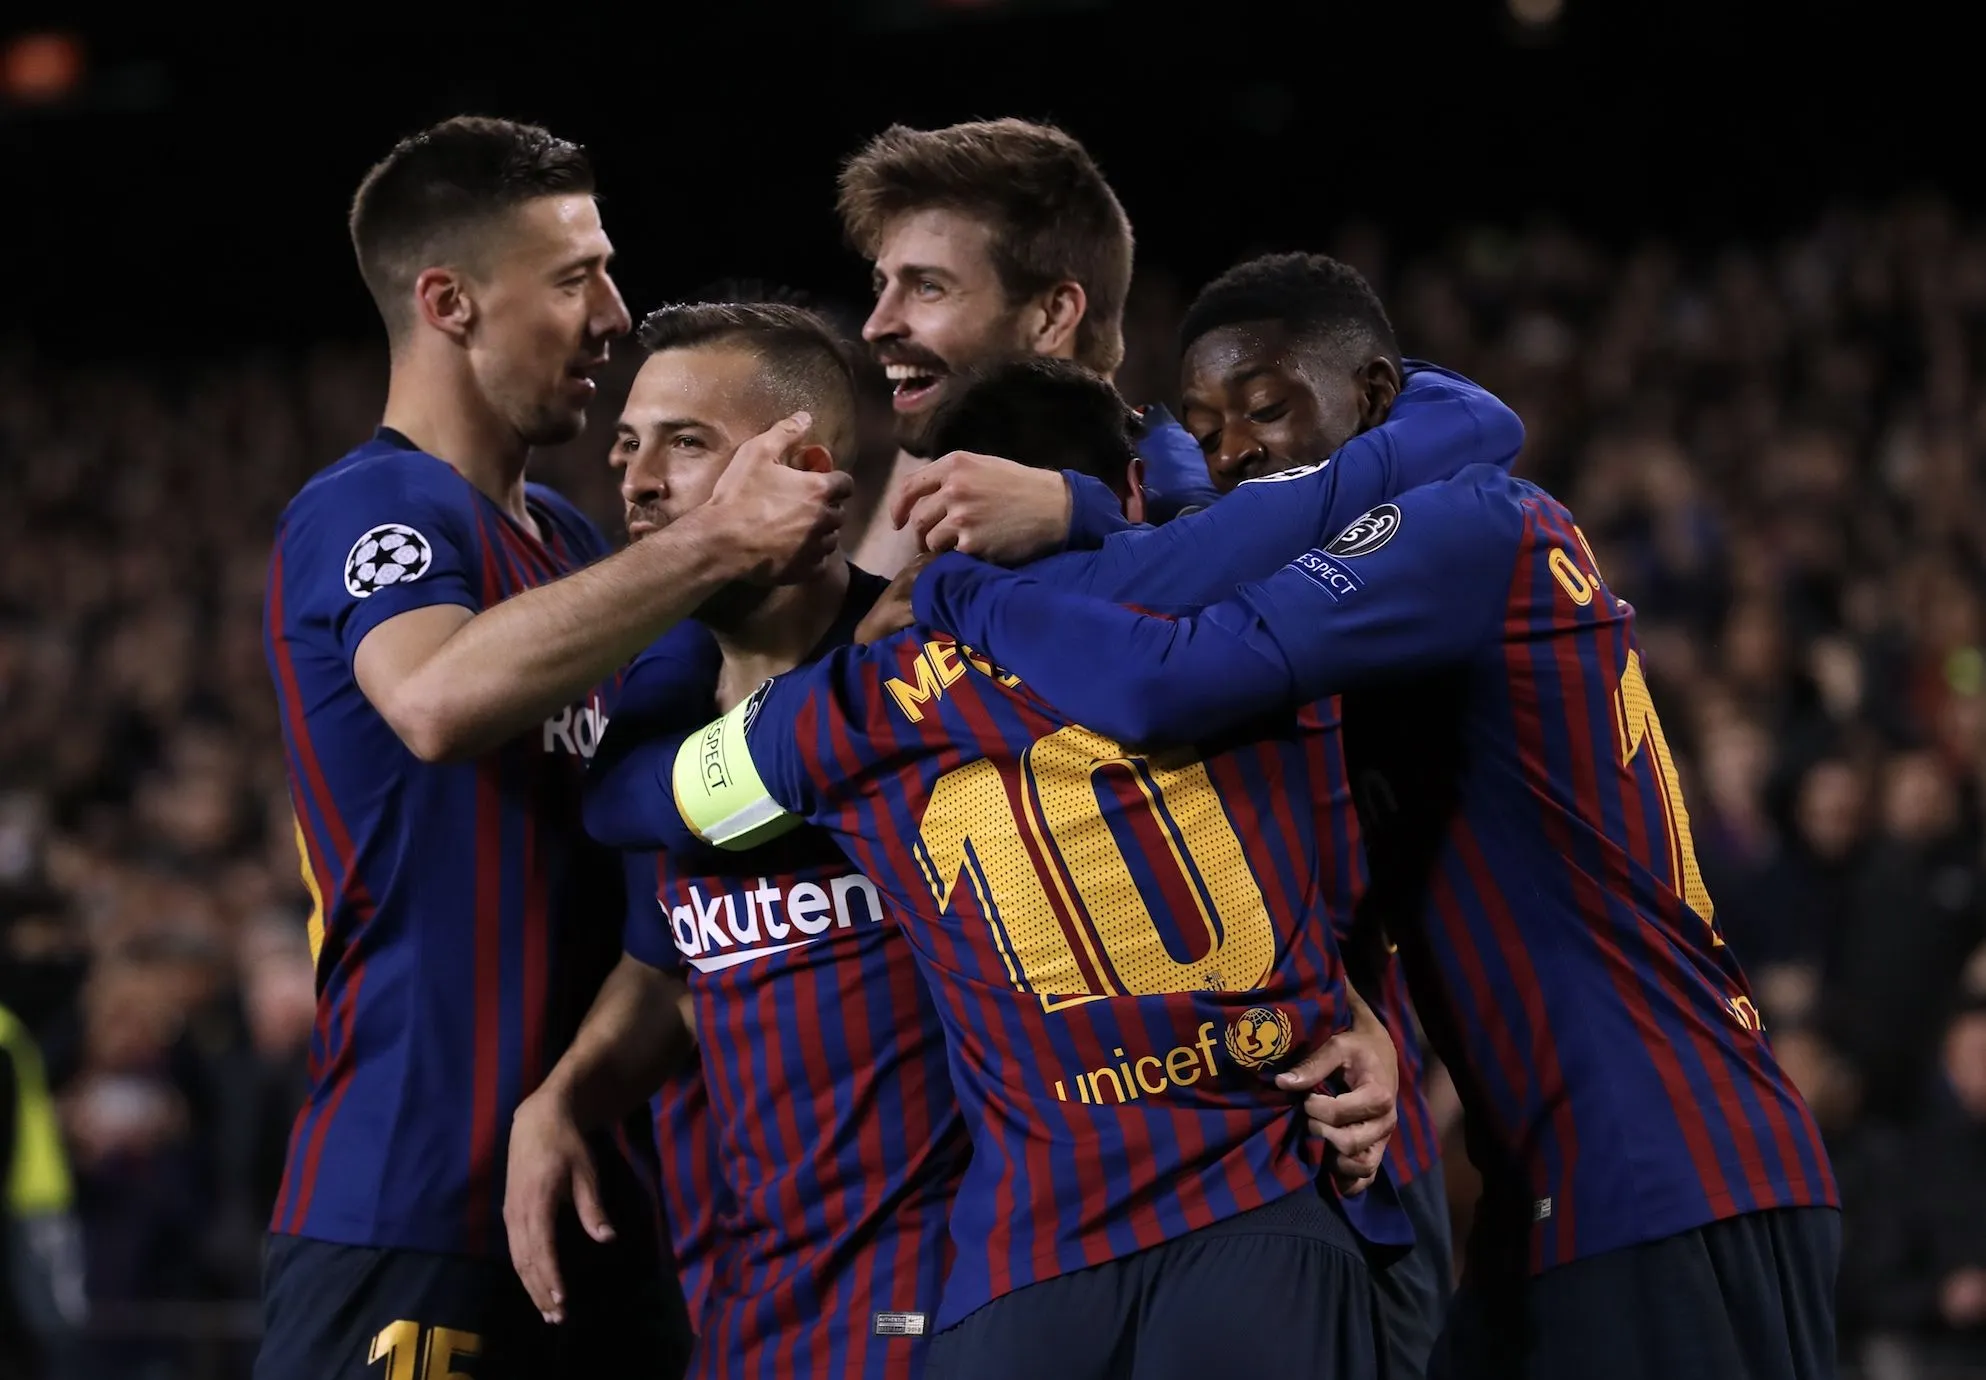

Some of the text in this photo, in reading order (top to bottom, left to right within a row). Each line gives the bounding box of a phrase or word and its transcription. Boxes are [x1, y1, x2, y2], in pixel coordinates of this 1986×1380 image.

[1295, 553, 1357, 594] ESPECT
[705, 718, 727, 788] ESPECT
[913, 724, 1276, 1014] 10
[658, 873, 884, 957] akuten
